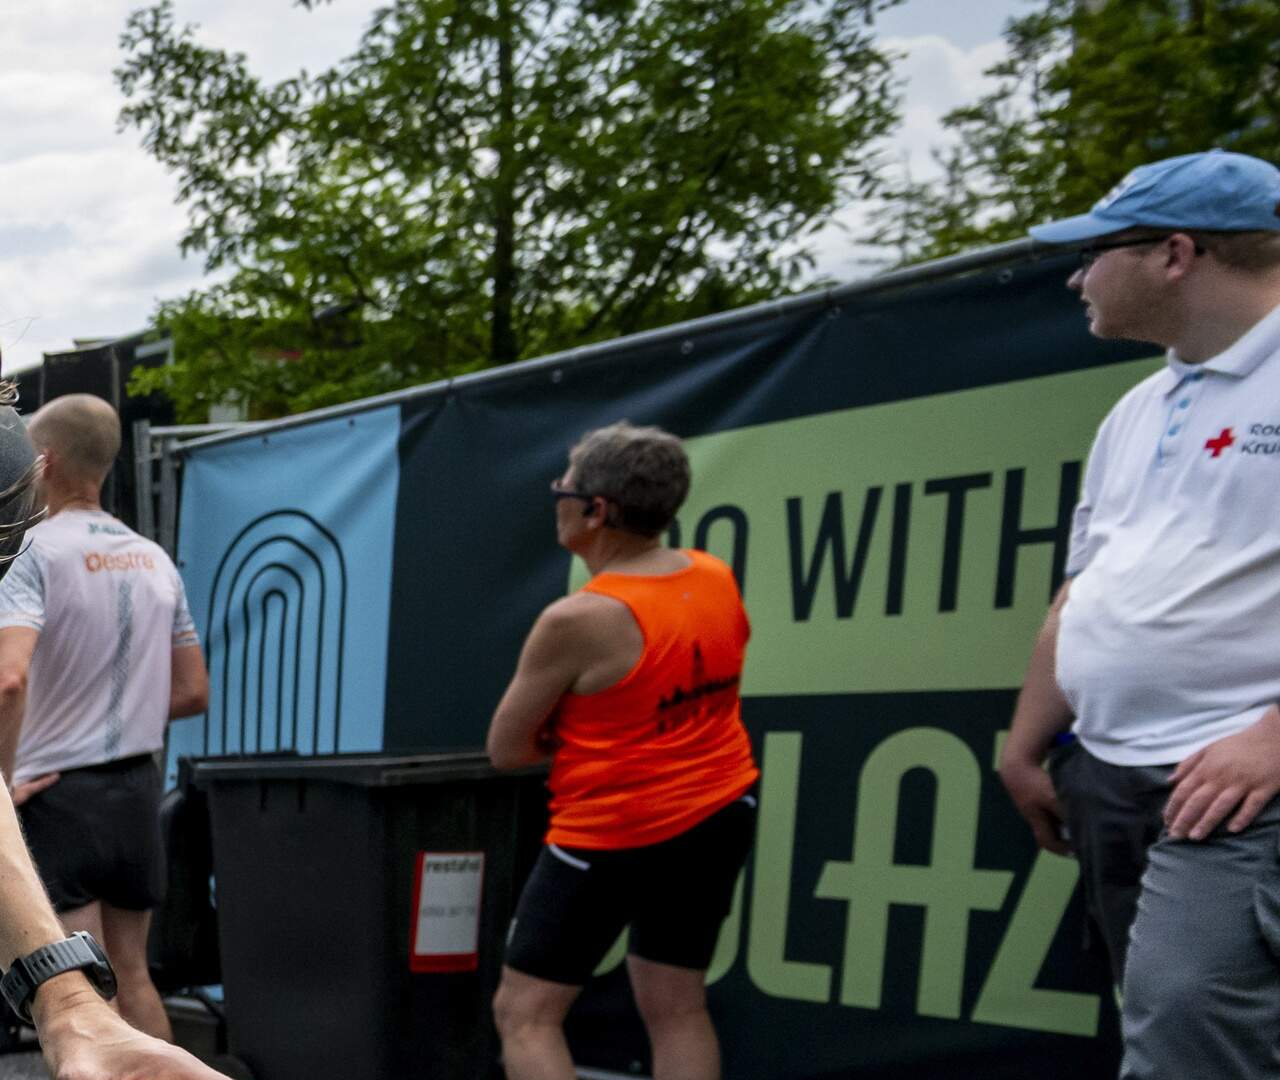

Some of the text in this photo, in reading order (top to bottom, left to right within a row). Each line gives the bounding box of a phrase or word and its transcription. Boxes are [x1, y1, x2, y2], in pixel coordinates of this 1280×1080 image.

[1241, 439, 1280, 455] Kru
[662, 460, 1082, 623] O WITH
